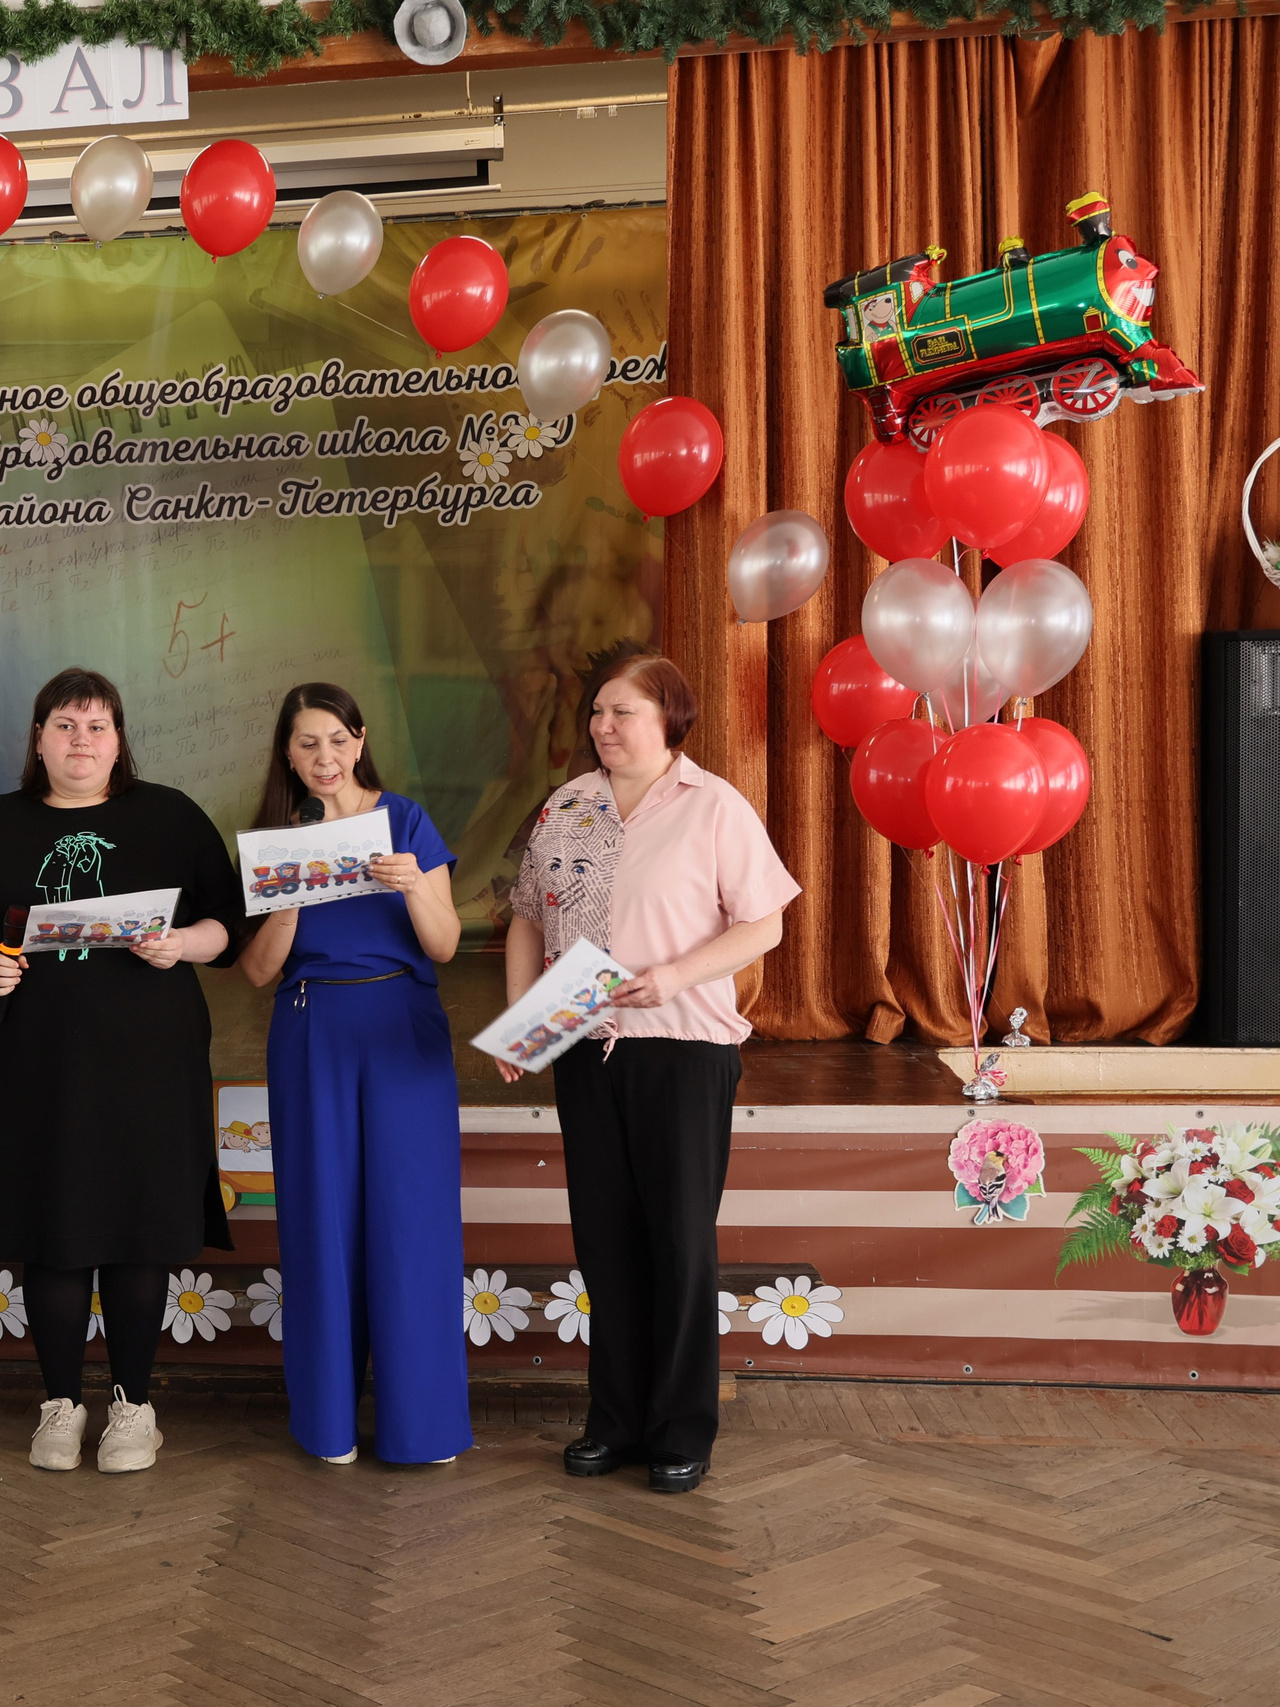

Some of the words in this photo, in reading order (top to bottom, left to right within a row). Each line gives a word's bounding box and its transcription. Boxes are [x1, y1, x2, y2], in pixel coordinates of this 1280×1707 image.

[76, 358, 520, 416] общеобразовательно
[317, 417, 447, 456] школа
[162, 591, 237, 679] 5+
